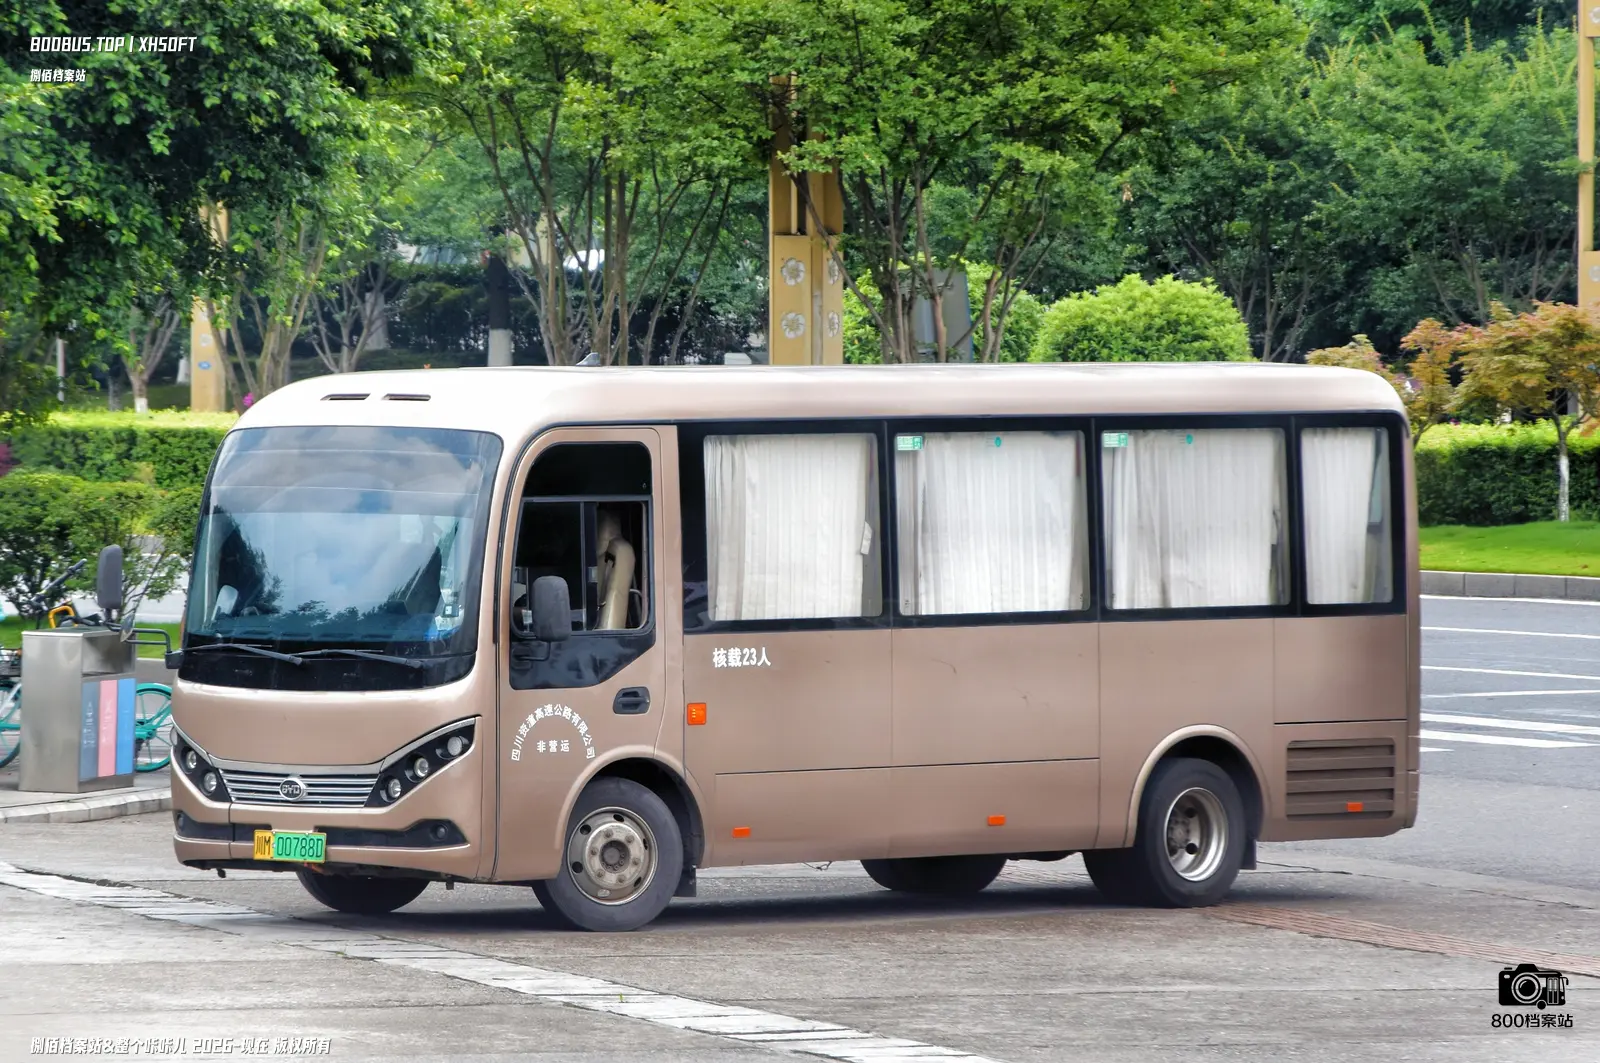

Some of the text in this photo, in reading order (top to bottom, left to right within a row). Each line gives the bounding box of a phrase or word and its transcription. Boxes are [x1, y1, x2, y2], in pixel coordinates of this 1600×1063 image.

[712, 646, 772, 668] 核载23人
[281, 784, 300, 795] BYD
